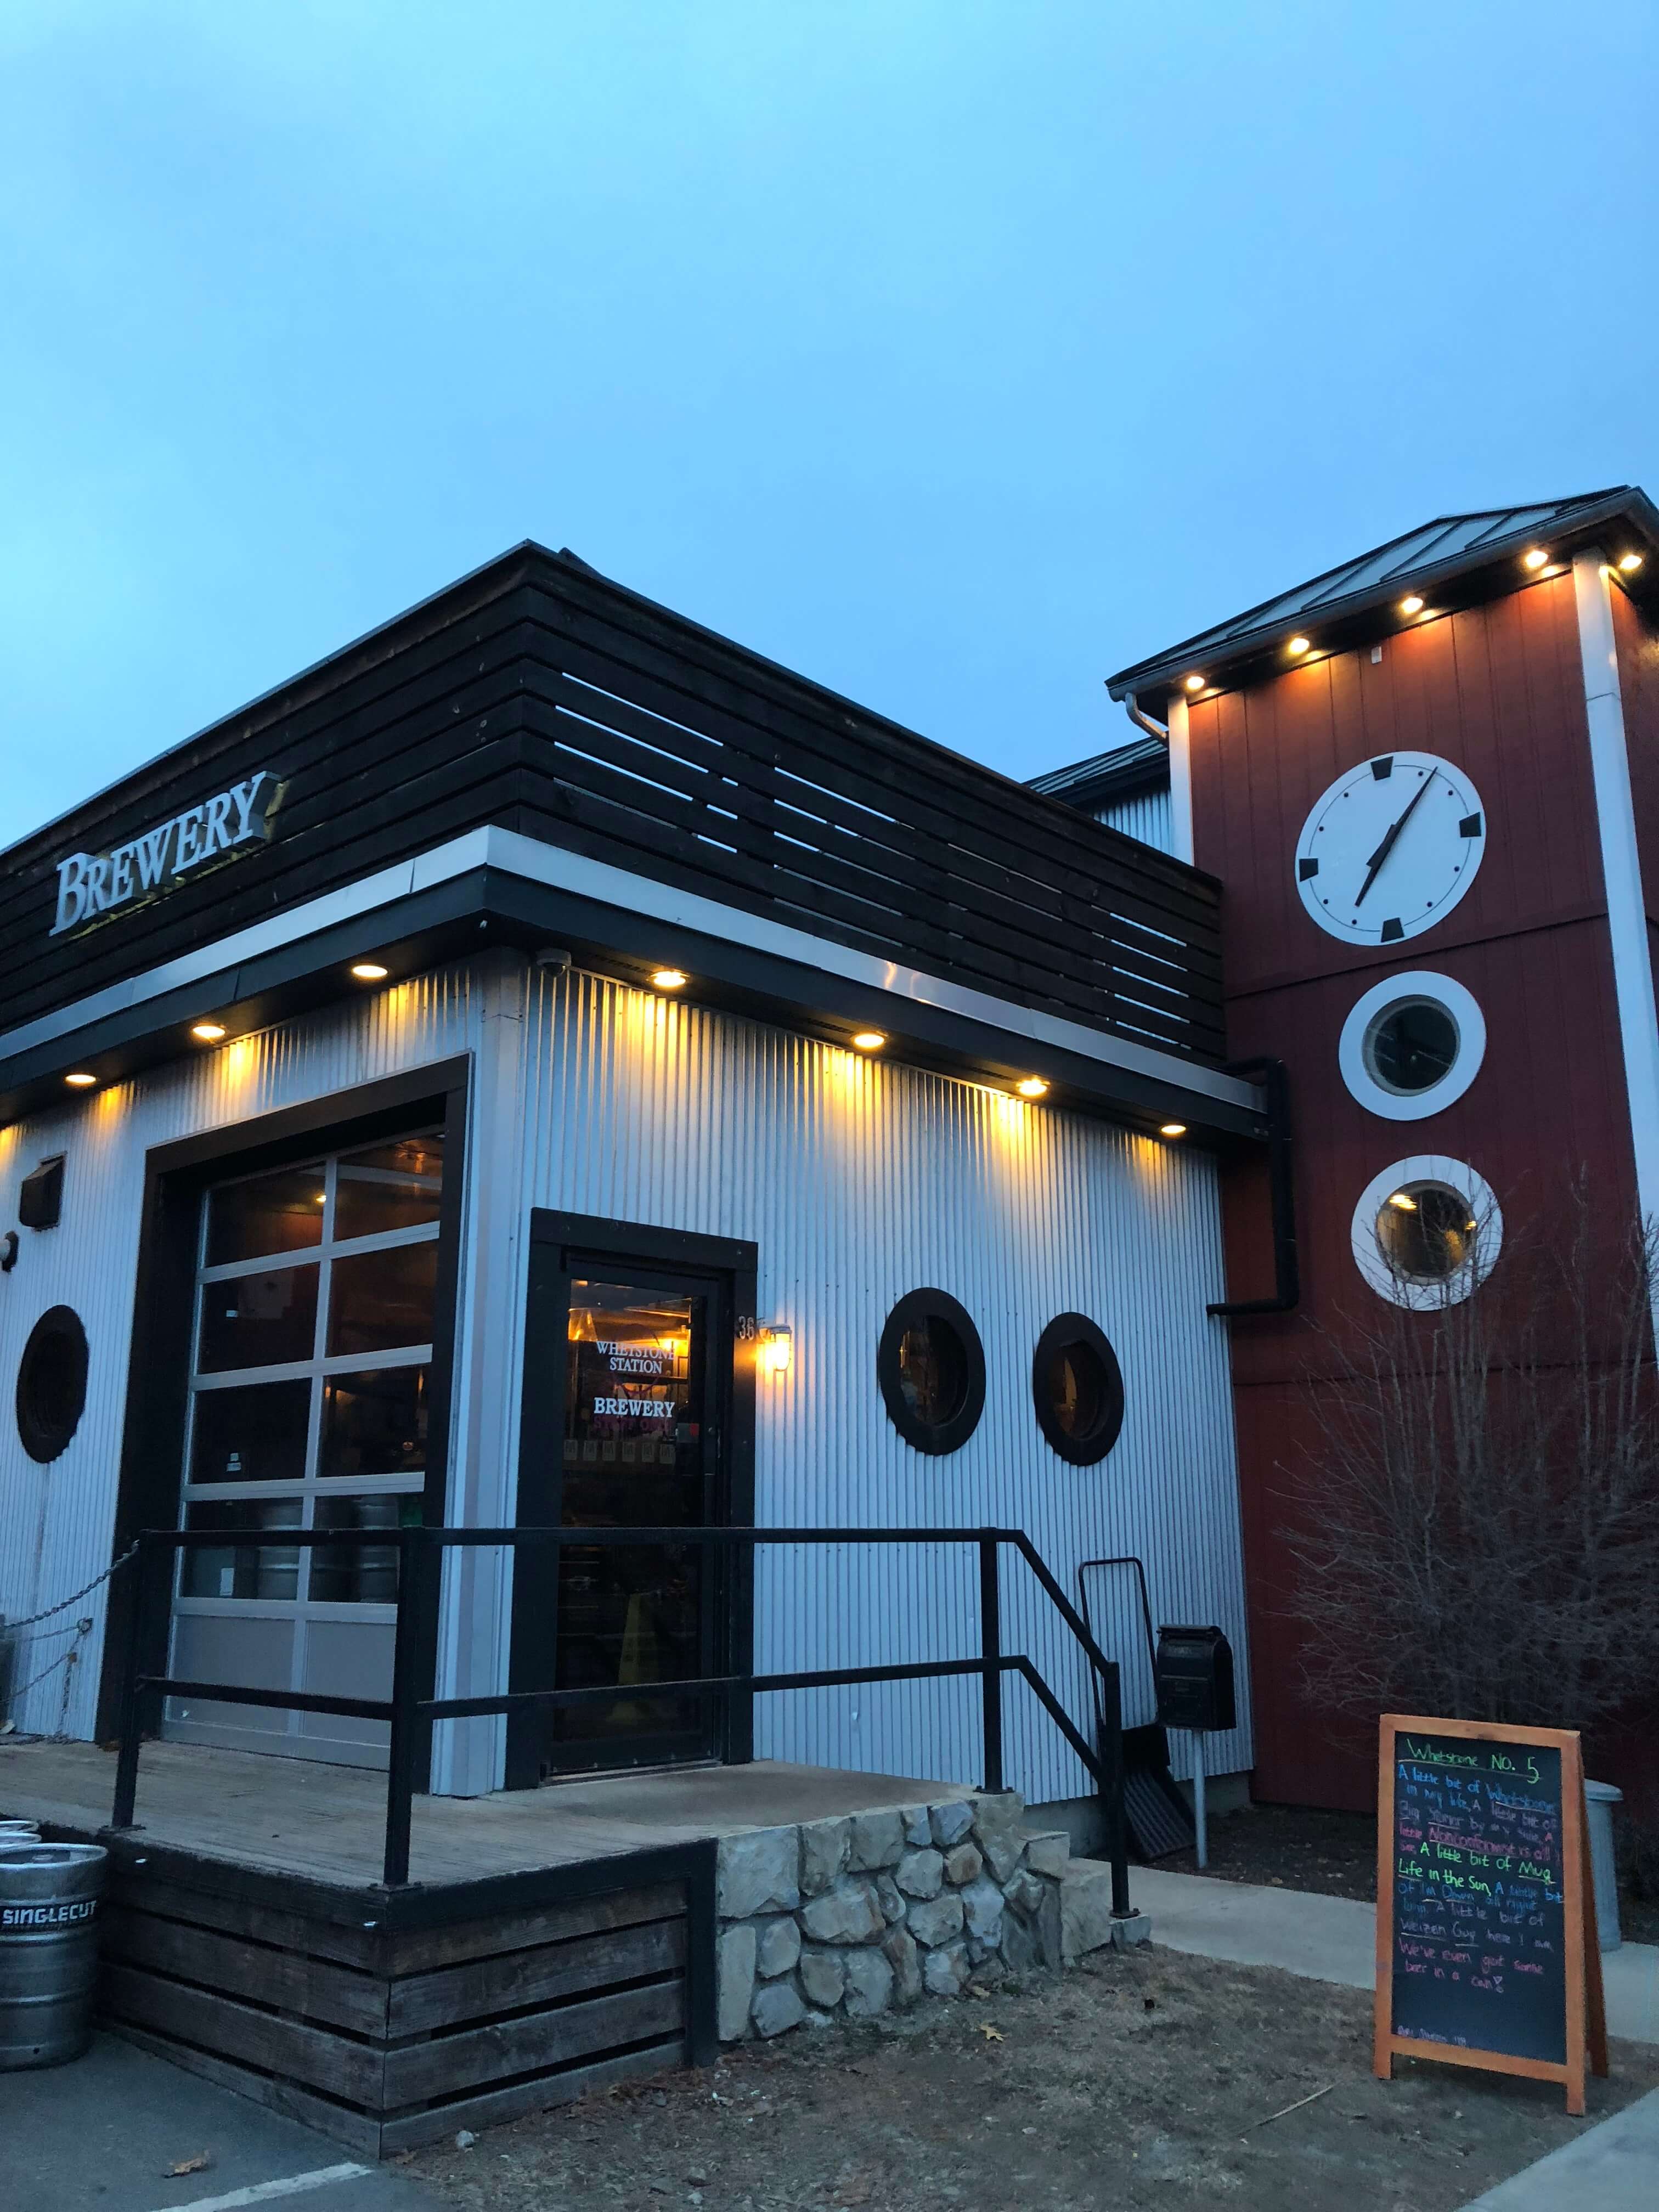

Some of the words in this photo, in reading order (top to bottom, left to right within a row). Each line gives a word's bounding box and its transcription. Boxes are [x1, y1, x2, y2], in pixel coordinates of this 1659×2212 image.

[49, 771, 279, 936] BREWERY
[596, 1340, 675, 1361] WHETSTONE
[610, 1357, 662, 1374] STATION
[594, 1397, 675, 1418] BREWERY
[1398, 1764, 1409, 1780] A
[1413, 1767, 1440, 1785] little
[1445, 1775, 1462, 1789] bit
[1467, 1779, 1481, 1793] of
[1527, 1757, 1539, 1784] 5
[1424, 1789, 1443, 1808] my
[1472, 1799, 1481, 1812] A
[1420, 1842, 1430, 1857] A
[1437, 1843, 1462, 1863] little
[1470, 1852, 1489, 1866] bit
[1518, 1861, 1551, 1885] Mug
[1398, 1858, 1424, 1877] Life
[1429, 1867, 1440, 1882] in
[1442, 1869, 1464, 1888] the
[1495, 1881, 1504, 1895] A
[1544, 1888, 1563, 1904] bit
[3, 1900, 97, 1925] SINGLECUT
[1453, 1921, 1476, 1944] Guy
